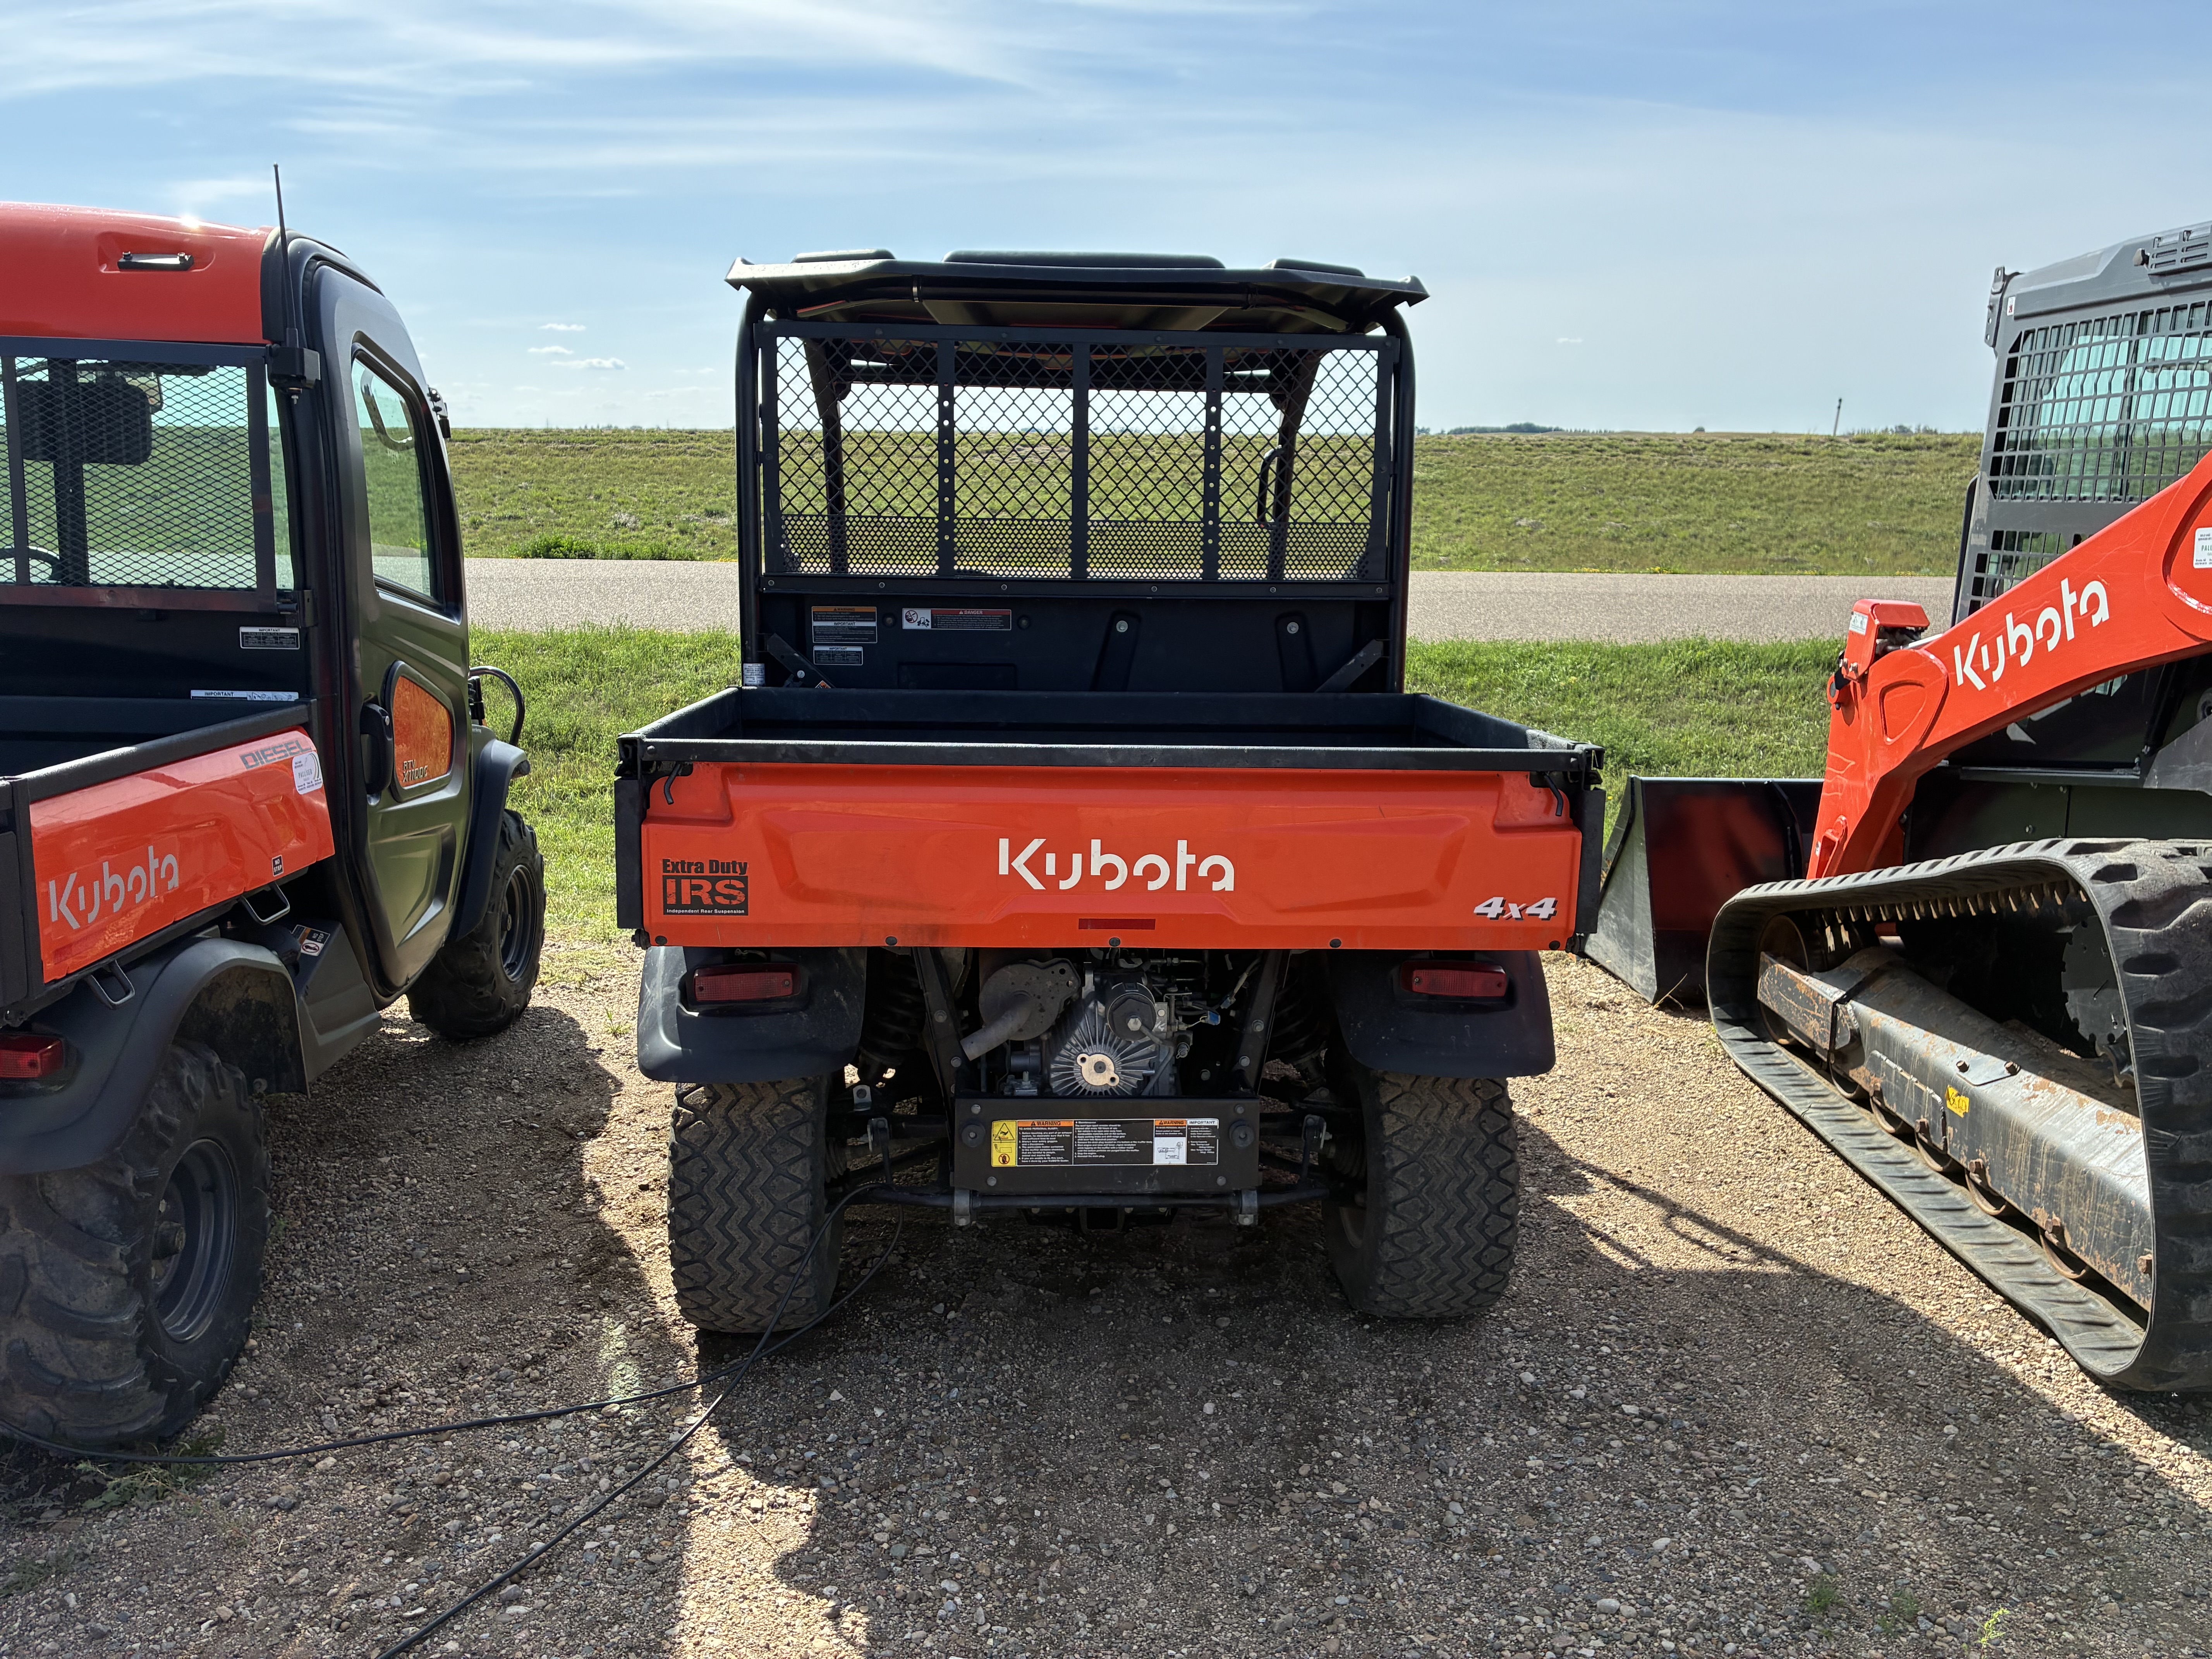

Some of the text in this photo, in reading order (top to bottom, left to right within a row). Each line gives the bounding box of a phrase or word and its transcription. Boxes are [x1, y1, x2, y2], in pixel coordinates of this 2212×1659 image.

[1954, 577, 2109, 691] Kubota
[240, 740, 311, 769] DIESEL
[402, 759, 416, 770] RTV
[663, 859, 748, 876] Extra Duty
[998, 838, 1235, 891] Kubota
[48, 845, 179, 929] Kubota
[666, 879, 745, 905] IRS
[1473, 896, 1558, 921] 4x4
